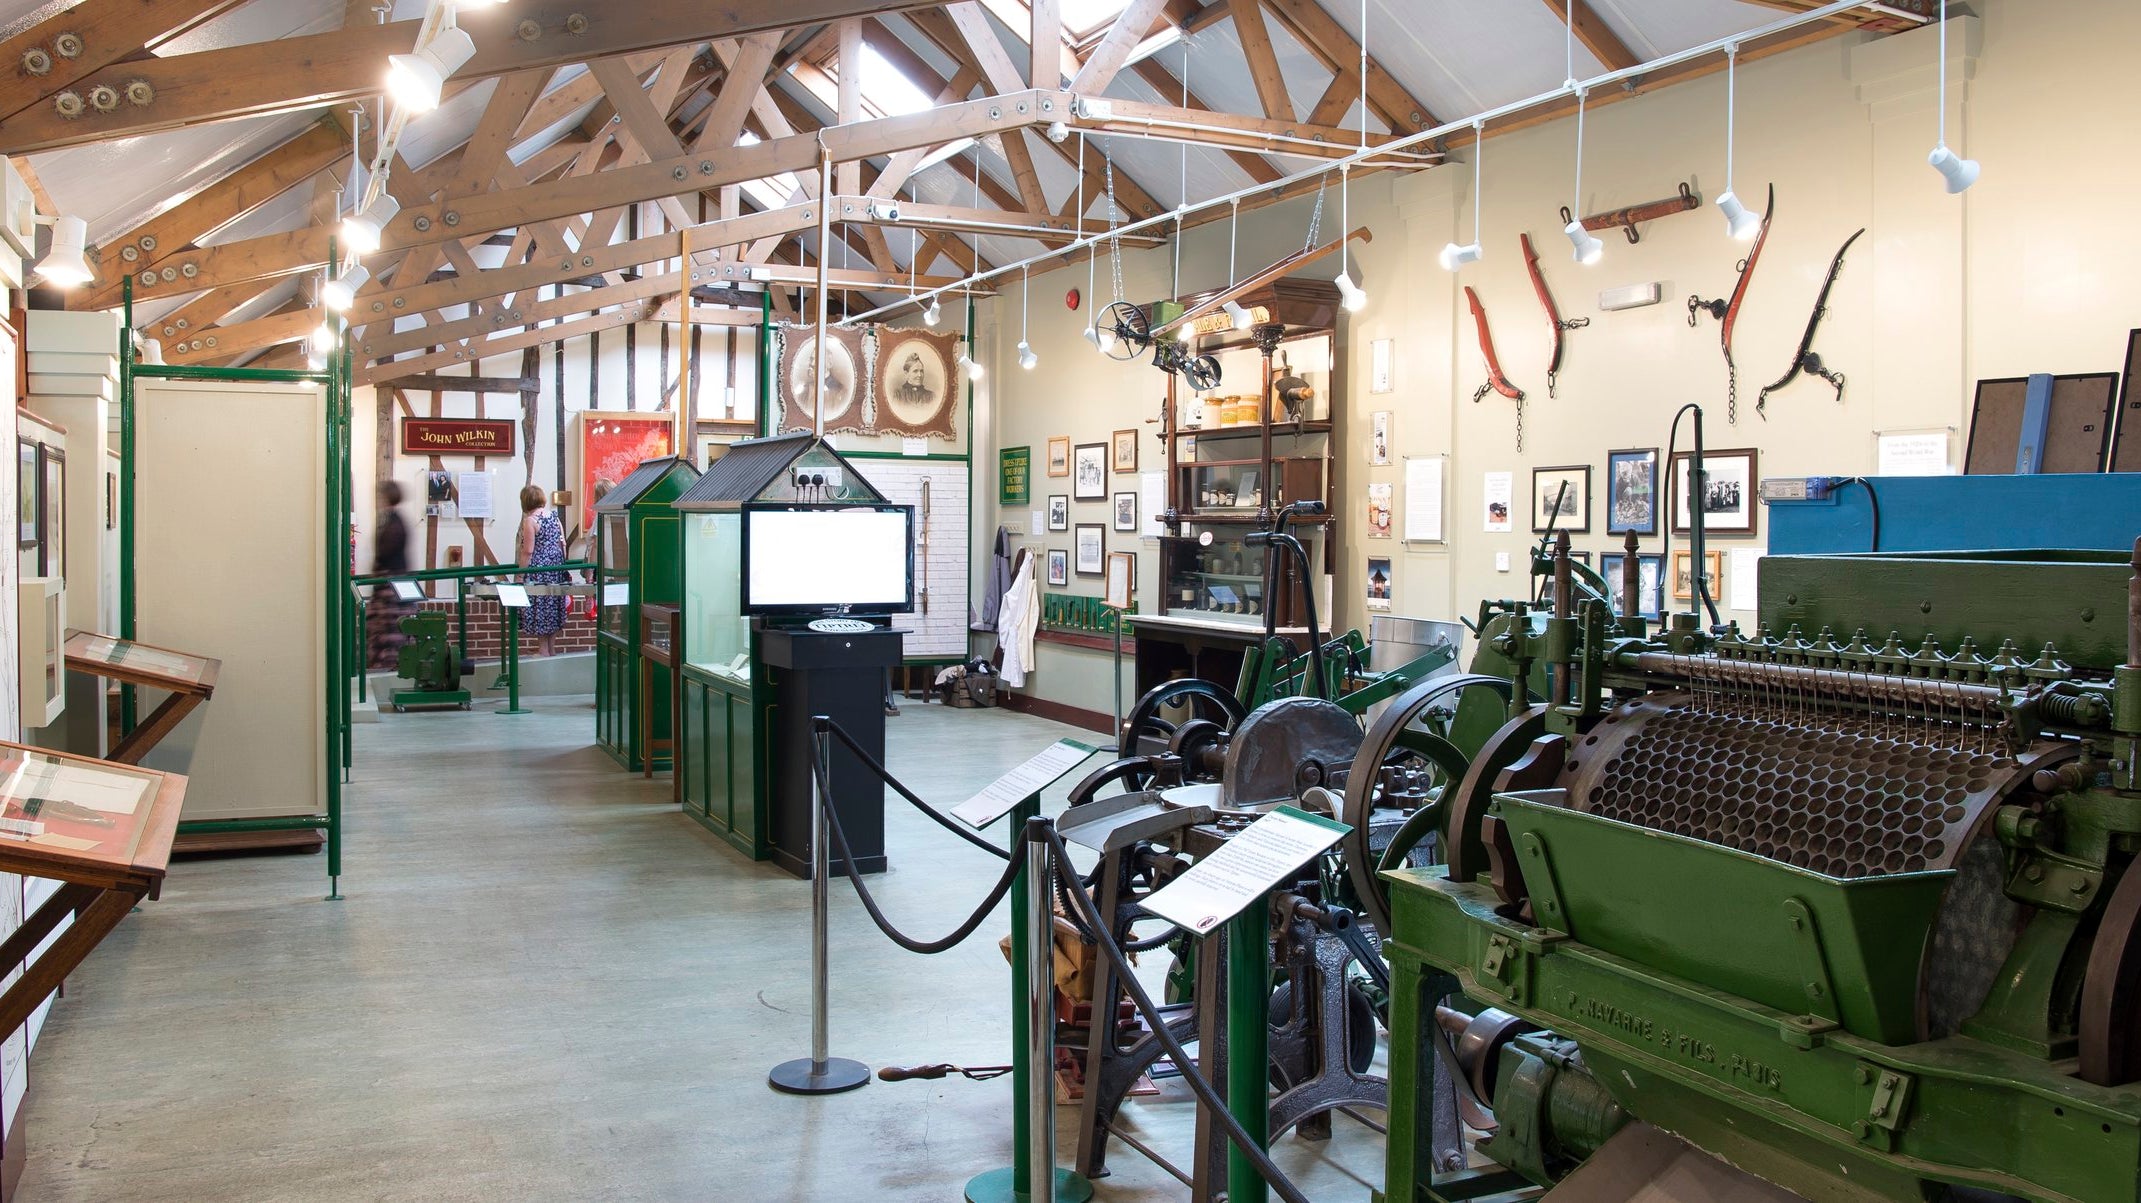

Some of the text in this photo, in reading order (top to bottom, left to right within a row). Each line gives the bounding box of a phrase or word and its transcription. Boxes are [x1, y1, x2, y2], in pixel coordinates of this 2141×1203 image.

[420, 430, 495, 444] JOHN WILKIN
[1661, 1027, 1673, 1049] &
